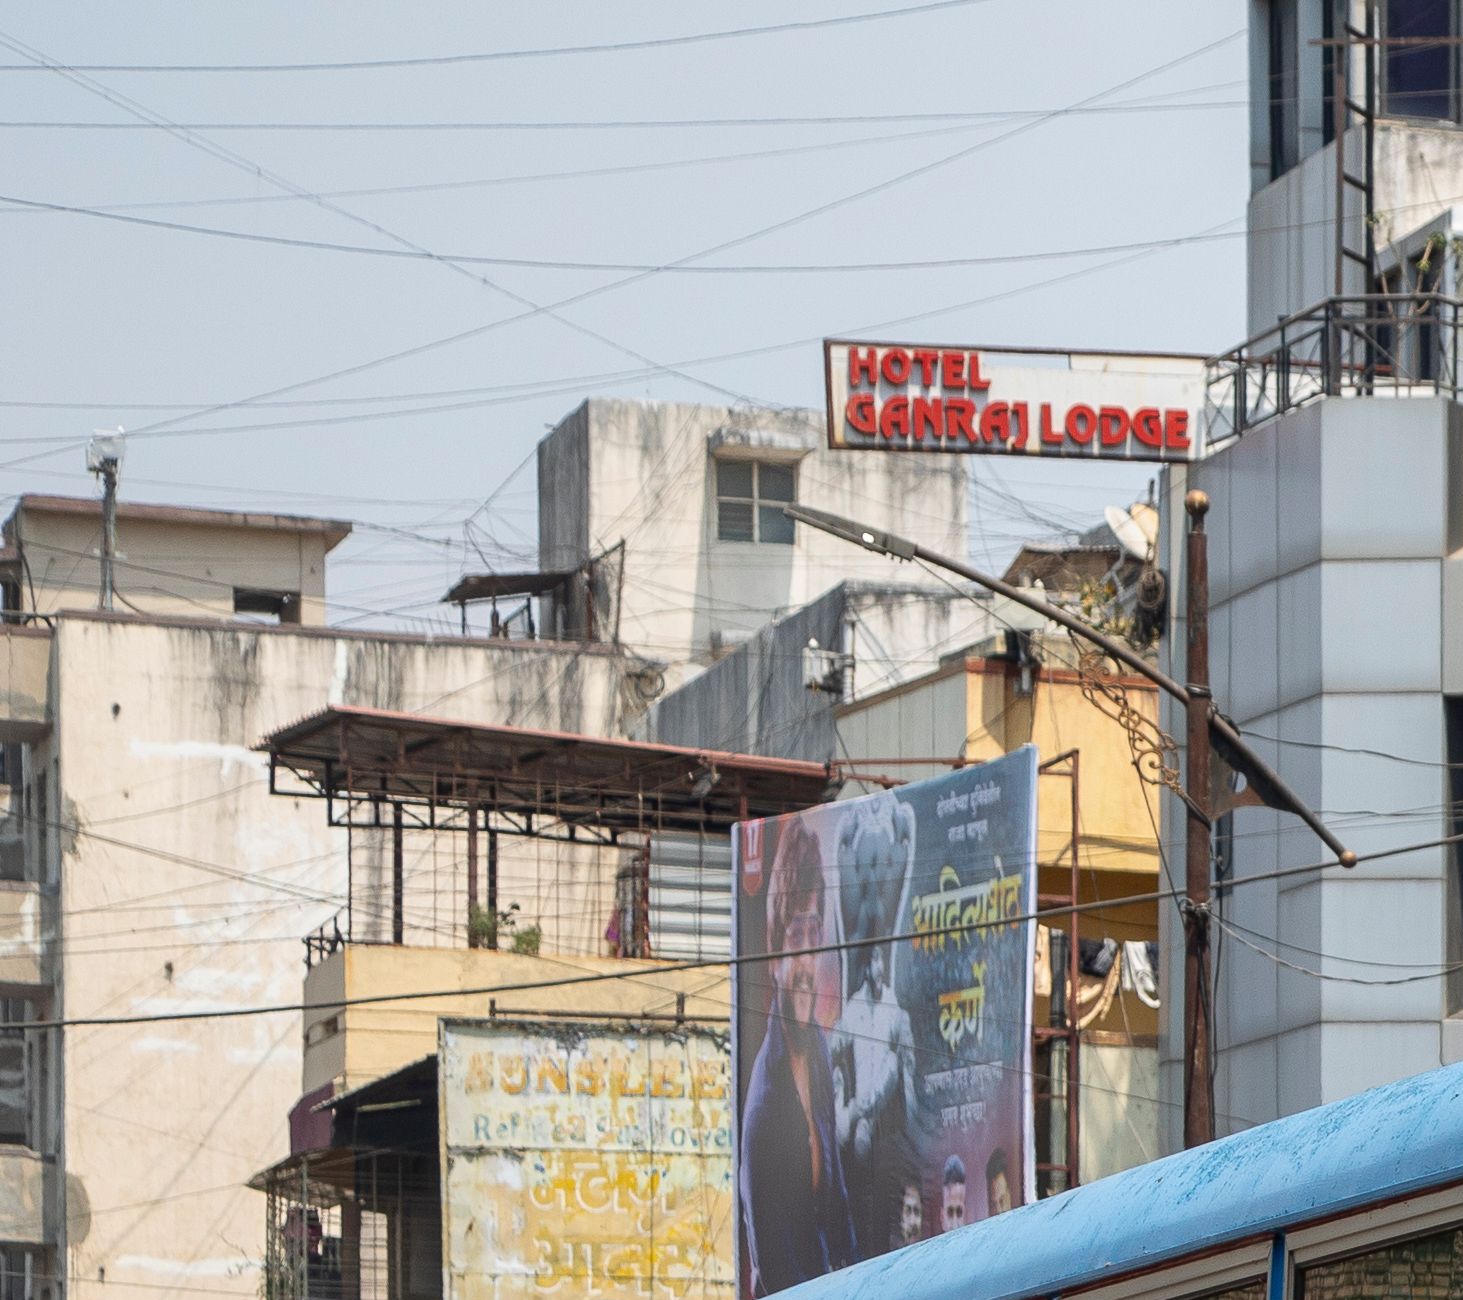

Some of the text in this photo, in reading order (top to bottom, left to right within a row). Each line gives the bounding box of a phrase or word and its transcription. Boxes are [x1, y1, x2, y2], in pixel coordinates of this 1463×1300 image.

[848, 346, 991, 390] HOTEL
[846, 394, 1191, 452] GANRAJ LODGE
